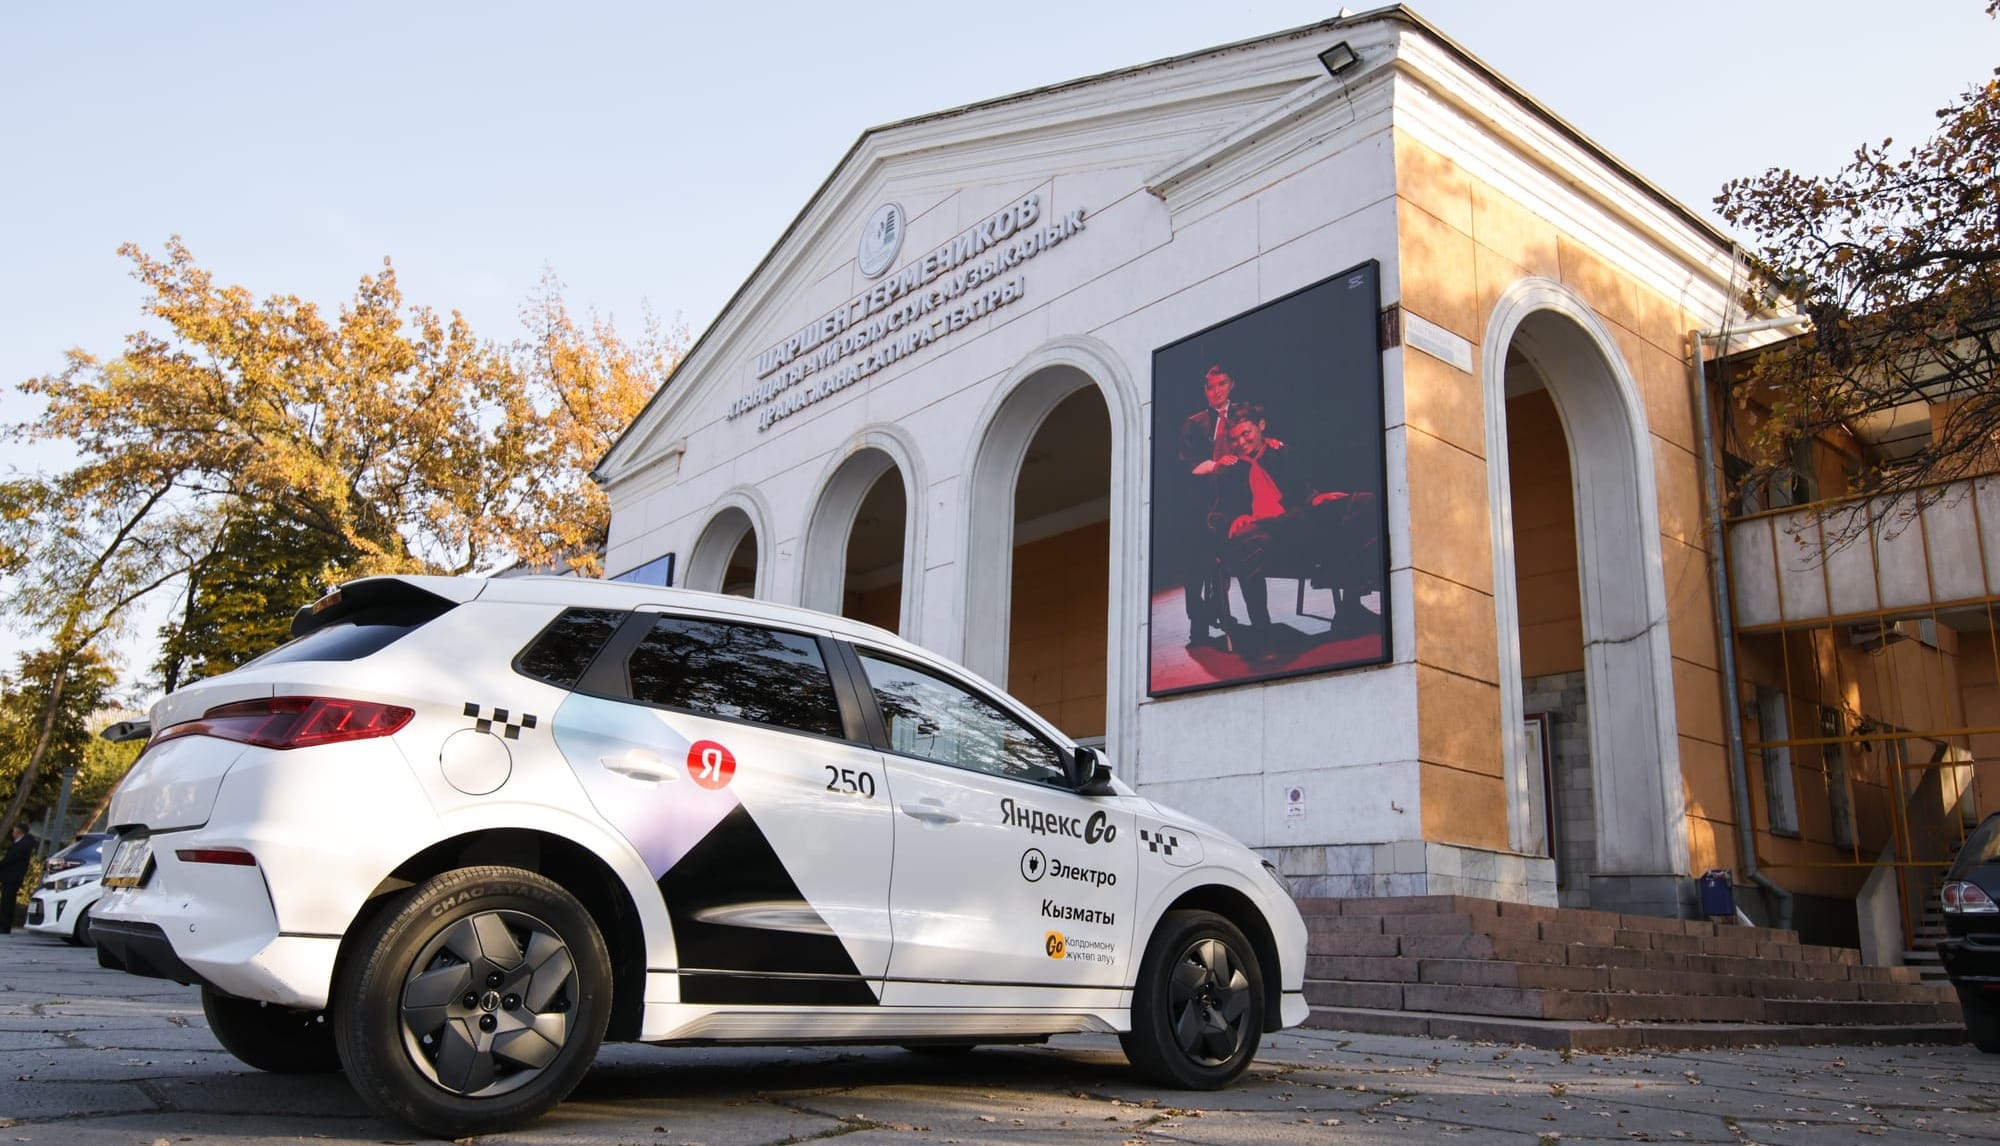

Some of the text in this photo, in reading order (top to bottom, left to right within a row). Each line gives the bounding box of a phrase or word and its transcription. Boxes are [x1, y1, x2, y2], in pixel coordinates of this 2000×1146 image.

[757, 195, 1040, 380] ШАРШЕН ТЕРМЕЧИКОВ
[727, 361, 806, 420] АТЫНДАГЫ
[843, 292, 939, 356] ОБЛУСТУК
[939, 206, 1086, 304] МУЗЫКАЛЫК
[758, 389, 808, 432] ДРАМА
[863, 323, 938, 372] САТИРА
[939, 275, 1025, 336] ТЕАТРЫ
[699, 748, 722, 782] Я
[825, 764, 875, 799] 250
[1000, 798, 1117, 844] Яндекс Go
[1050, 858, 1117, 888] Электро
[1041, 898, 1115, 926] Кызматы
[1045, 934, 1063, 957] Go
[1064, 937, 1115, 953] Колдонмону
[1096, 953, 1115, 965] алуу
